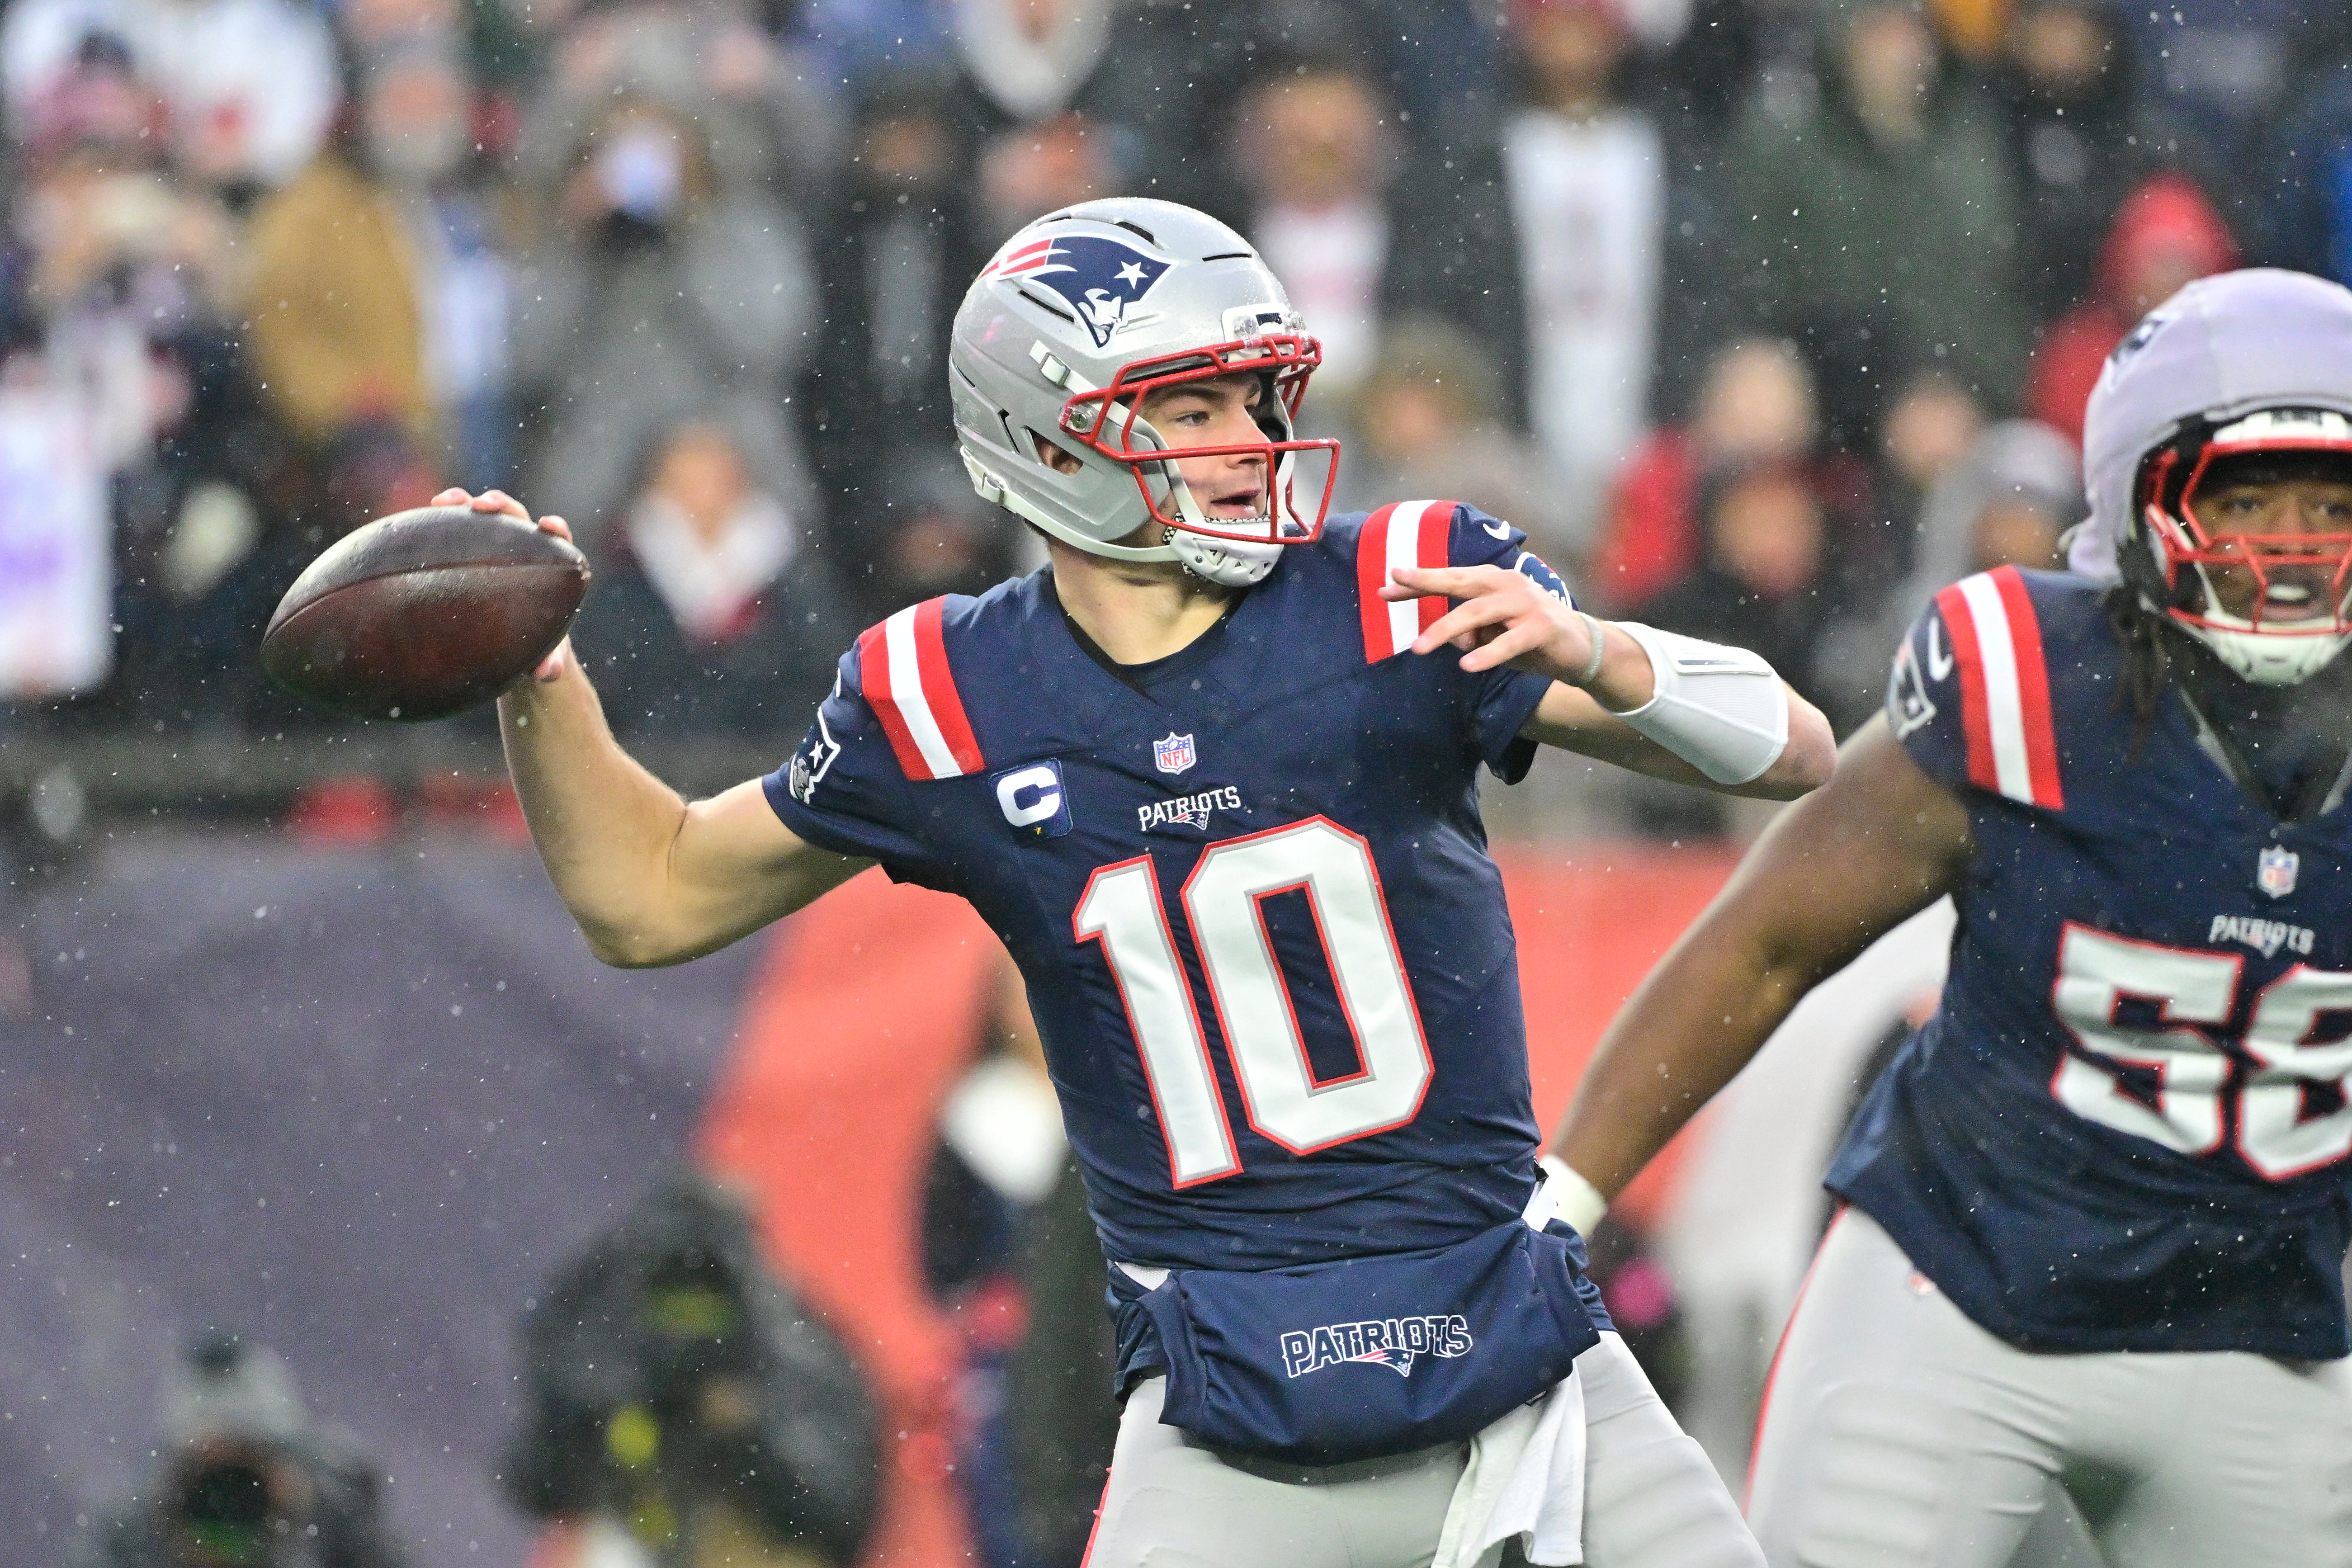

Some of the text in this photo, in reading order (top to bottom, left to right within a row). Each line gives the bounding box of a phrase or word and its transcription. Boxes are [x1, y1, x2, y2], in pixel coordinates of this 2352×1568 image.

[1162, 749, 1190, 767] NFL
[997, 767, 1060, 827] C
[1138, 786, 1241, 831] PATRIOTS
[1072, 814, 1434, 1189] 10
[1281, 1315, 1473, 1378] PATRIOTS
